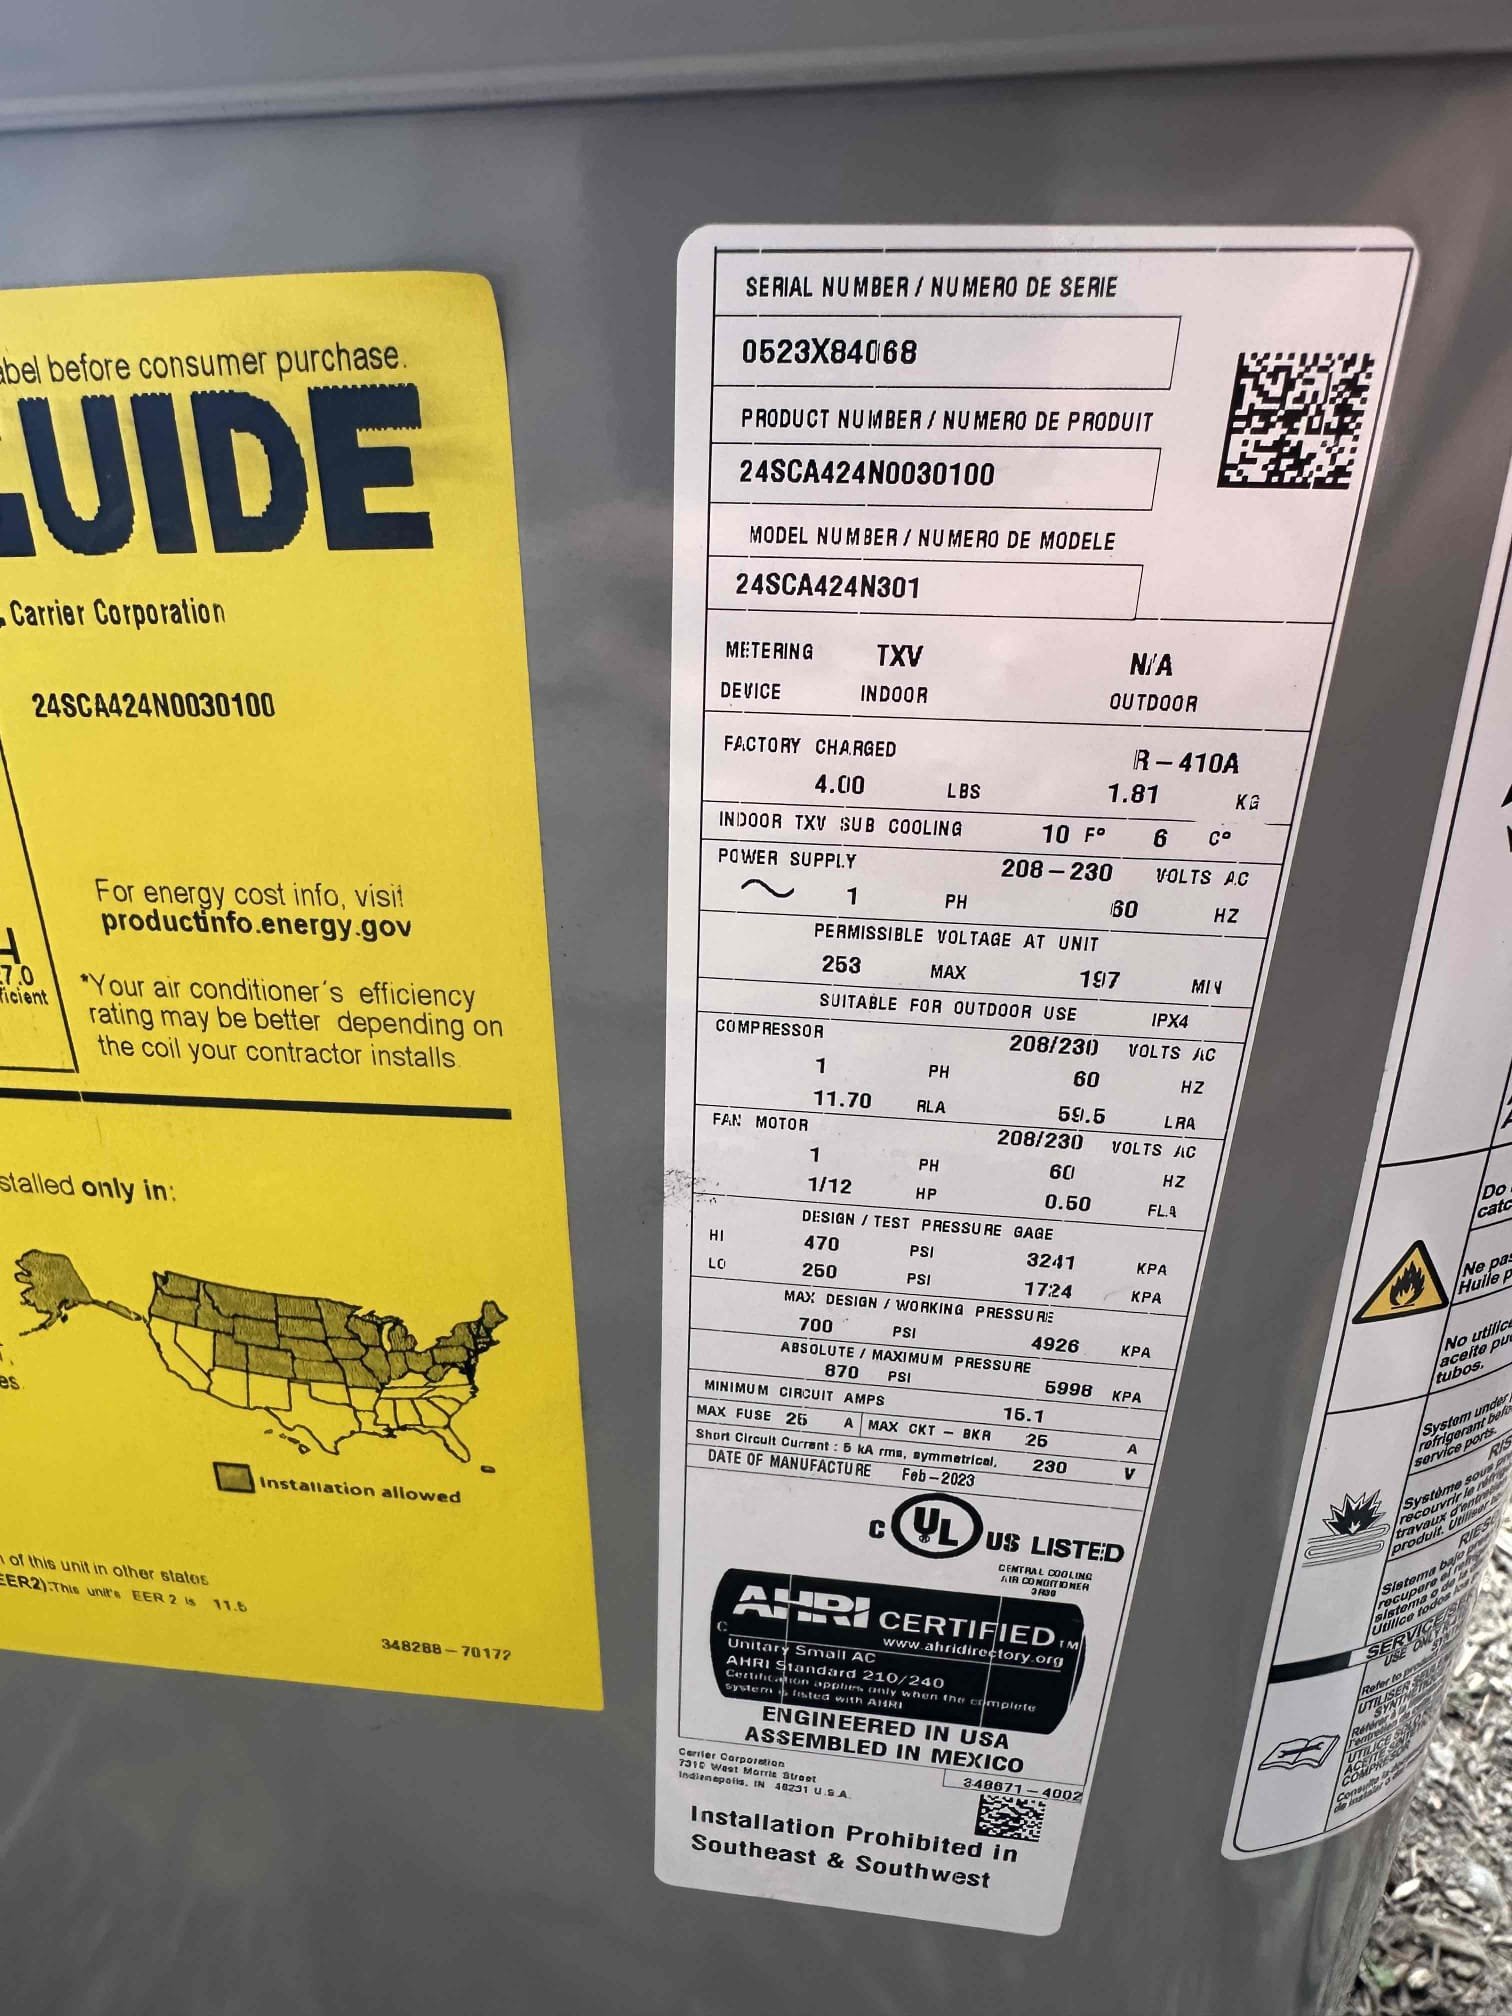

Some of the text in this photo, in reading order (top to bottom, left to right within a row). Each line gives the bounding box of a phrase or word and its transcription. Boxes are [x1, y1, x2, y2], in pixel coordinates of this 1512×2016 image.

[746, 276, 1118, 298] SERIAL NUMBER NUMERO DE SERIE
[47, 352, 131, 382] before
[139, 351, 267, 379] consumer
[276, 341, 407, 382] purchase.
[743, 337, 917, 364] 0523X84068
[742, 408, 1154, 432] PRODUCT NUMBER NUMERO DE PRODUIT
[740, 458, 995, 486] 24SCA424N0030100
[750, 525, 1116, 550] MODEL NUMBER NUMERO DE MODELE
[736, 572, 919, 599] 24SCA424N301
[9, 597, 225, 630] Carrier Corporation
[726, 641, 813, 660] METERING
[877, 644, 924, 667] TXV
[32, 692, 275, 718] 24SCA424N0030100
[721, 681, 1198, 712] DEVICE INDOOR OUTDOOR
[724, 735, 801, 754] FACTORY
[816, 739, 896, 757] CHARGED
[815, 774, 1158, 804] 4.00 LBS 1.81
[720, 811, 962, 837] INDOOR TXV SUB COOLING
[718, 848, 778, 865] POWER
[790, 851, 857, 869] SUPPLY
[1157, 868, 1212, 885] VOLTS
[95, 878, 403, 910] For energy cost info, visit
[101, 908, 411, 942] productinfo.energy.gov
[815, 923, 1099, 952] PERMISSIBLE VOLTAGE AT UNIT
[822, 955, 967, 980] 253 MAX
[154, 976, 180, 997] air
[360, 981, 475, 1013] efficiency
[89, 1002, 503, 1041] rating may be better depending on
[820, 993, 1188, 1029] SUITABLE FOR OUTDOOR USE IPX4
[97, 1034, 135, 1056] the
[142, 1037, 181, 1058] coil
[188, 1043, 237, 1064] your
[246, 1042, 362, 1065] contractor
[716, 1019, 1099, 1056] COMPRESSOR 208/230
[813, 1090, 946, 1114] 11.70 RLA
[756, 1115, 1083, 1150] MOTOR 208/230
[81, 1177, 134, 1204] only
[143, 1179, 176, 1201] in:
[1482, 1184, 1506, 1200] Do
[802, 1210, 1053, 1240] DESIGN TEST PRESSURE GAGE
[804, 1235, 1075, 1270] 470 3241
[1462, 1261, 1485, 1277] Ne
[1458, 1272, 1500, 1295] Huile
[826, 1293, 963, 1316] DESIGN WORKING
[799, 1317, 1080, 1353] 700 4926
[1445, 1336, 1467, 1350] No
[780, 1341, 1031, 1373] ABSOLUTE MAXIMUM PRESSURE
[1440, 1344, 1488, 1367] aceite
[705, 1379, 885, 1406] MINIMUM CIRCUIT AMPS
[1423, 1411, 1472, 1436] System
[708, 1448, 741, 1464] DATE
[747, 1452, 763, 1466] OF
[770, 1454, 871, 1477] MANUFACTURE
[260, 1476, 461, 1503] Installation allowed
[1031, 1536, 1125, 1563] LISTED
[28, 1555, 154, 1580] this unit other
[732, 1584, 1055, 1647] AHRI CERTIFIED
[728, 1636, 846, 1662] Unitary Small
[726, 1654, 945, 1690] AHRI Standard 210/240
[762, 1705, 1008, 1750] ENGINEERED IN USA
[744, 1725, 1024, 1773] ASSEMBLED IN MEXICO
[691, 1805, 1018, 1862] Installation Prohibited in
[691, 1834, 990, 1888] Southeast & Southwest
